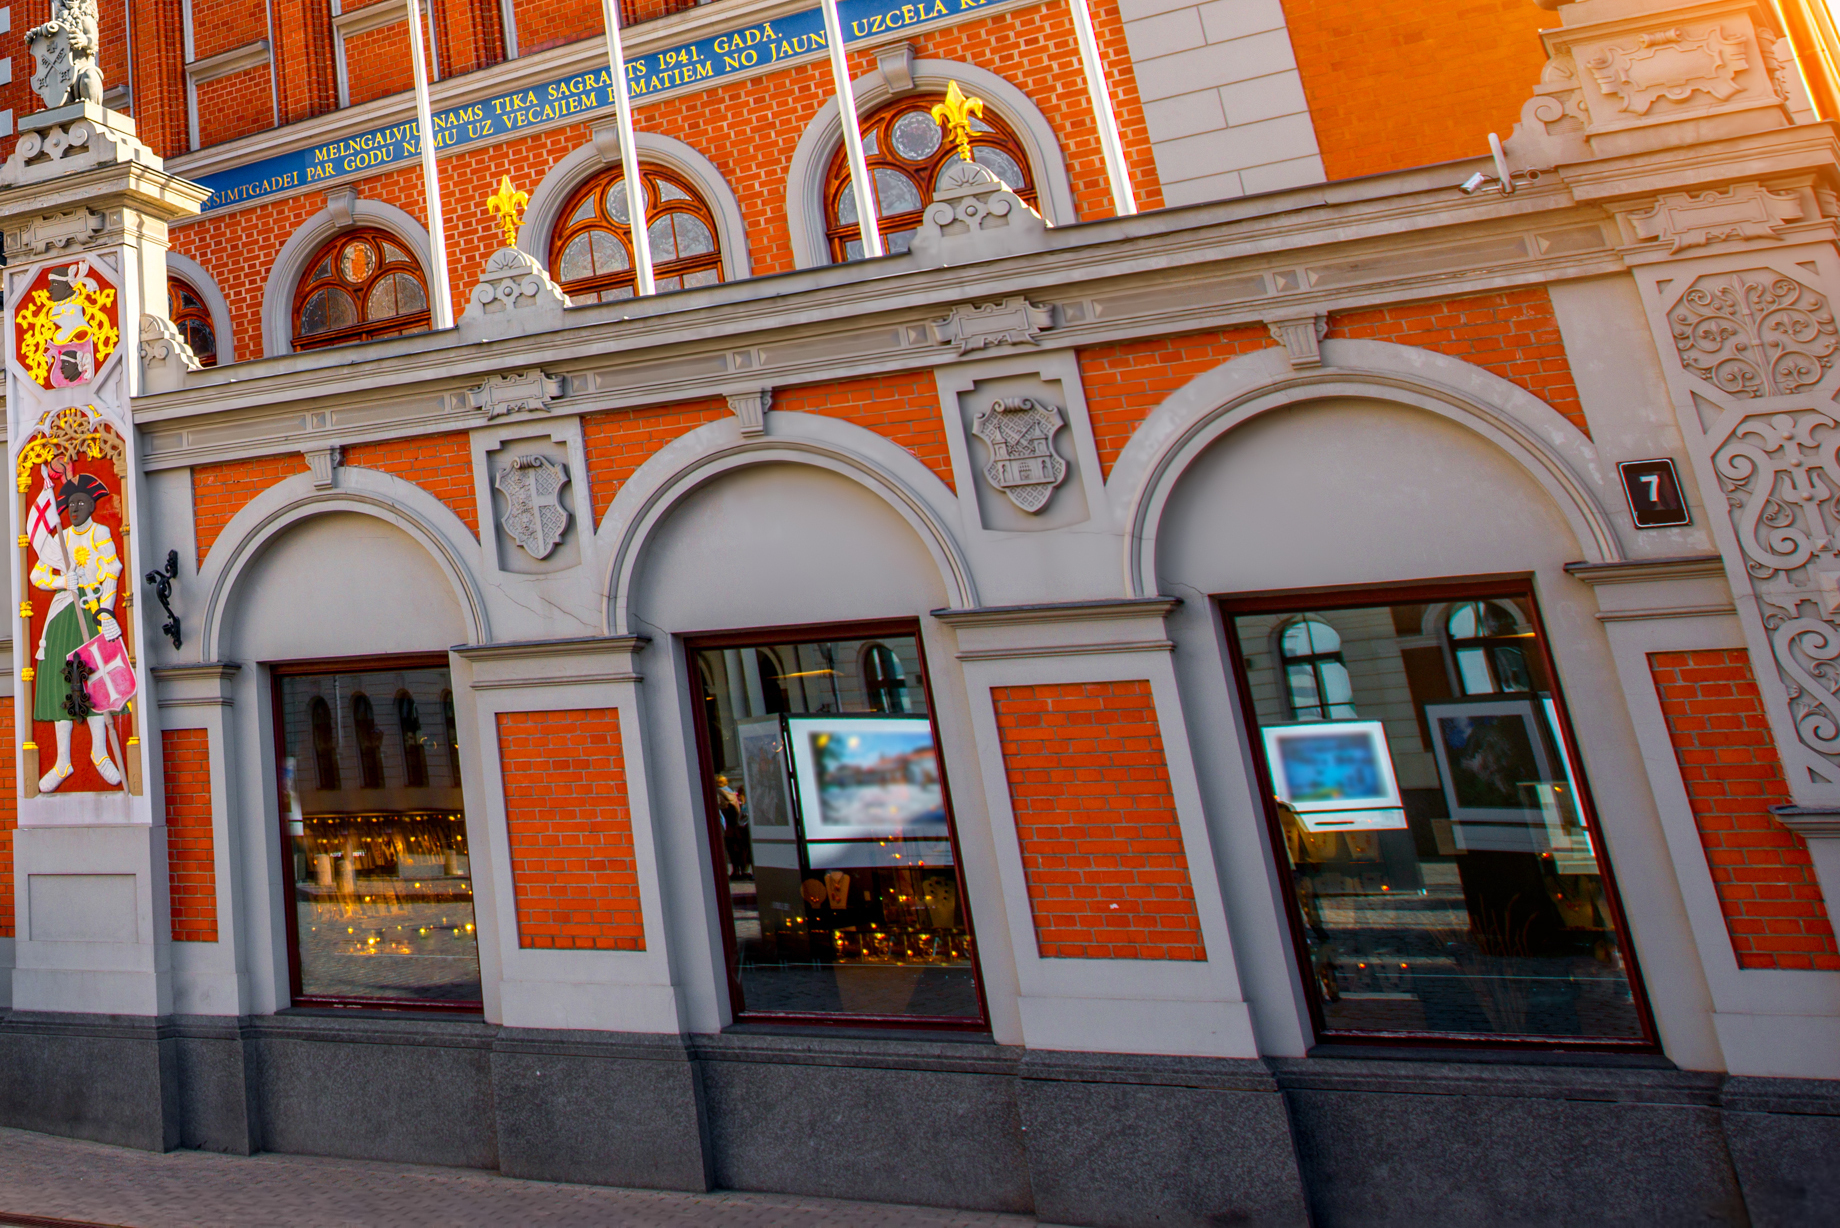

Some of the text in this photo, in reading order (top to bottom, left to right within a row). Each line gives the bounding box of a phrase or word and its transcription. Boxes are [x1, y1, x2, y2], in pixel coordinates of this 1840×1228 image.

[307, 163, 336, 182] PAR
[344, 146, 394, 171] GODU
[468, 120, 494, 138] UZ
[502, 92, 597, 129] VECAJIEM
[607, 61, 714, 103] PMATIEM
[723, 49, 758, 72] NO
[433, 105, 483, 131] NAMS
[492, 91, 538, 115] TIKA
[548, 60, 647, 101] SAGRATS
[658, 46, 704, 70] 1941.
[714, 22, 783, 54] GADĀ.
[1640, 474, 1660, 502] 7
